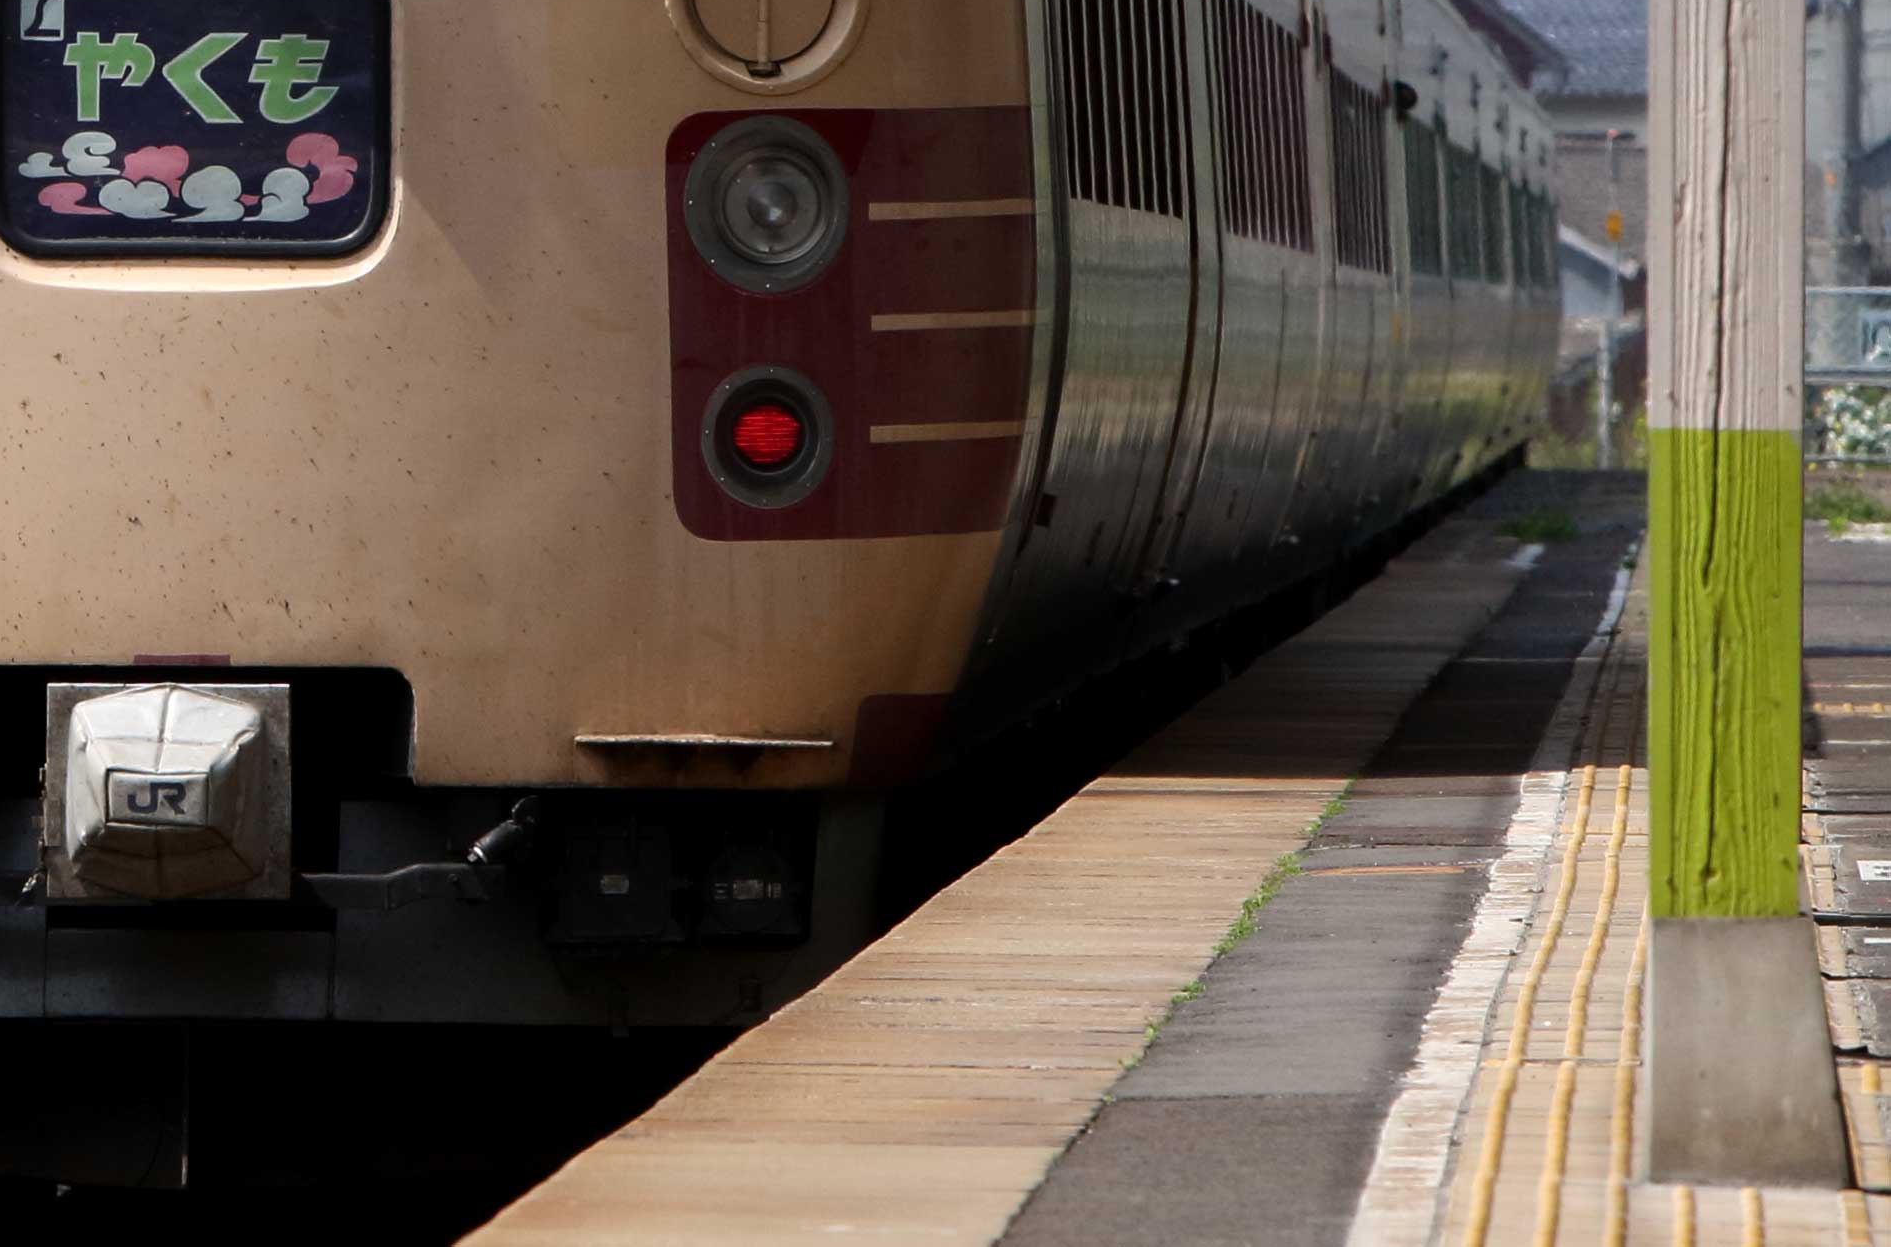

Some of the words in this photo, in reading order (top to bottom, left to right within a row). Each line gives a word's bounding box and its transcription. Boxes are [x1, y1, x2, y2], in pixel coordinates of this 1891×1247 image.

[62, 31, 340, 125] やくも
[127, 782, 186, 815] JR
